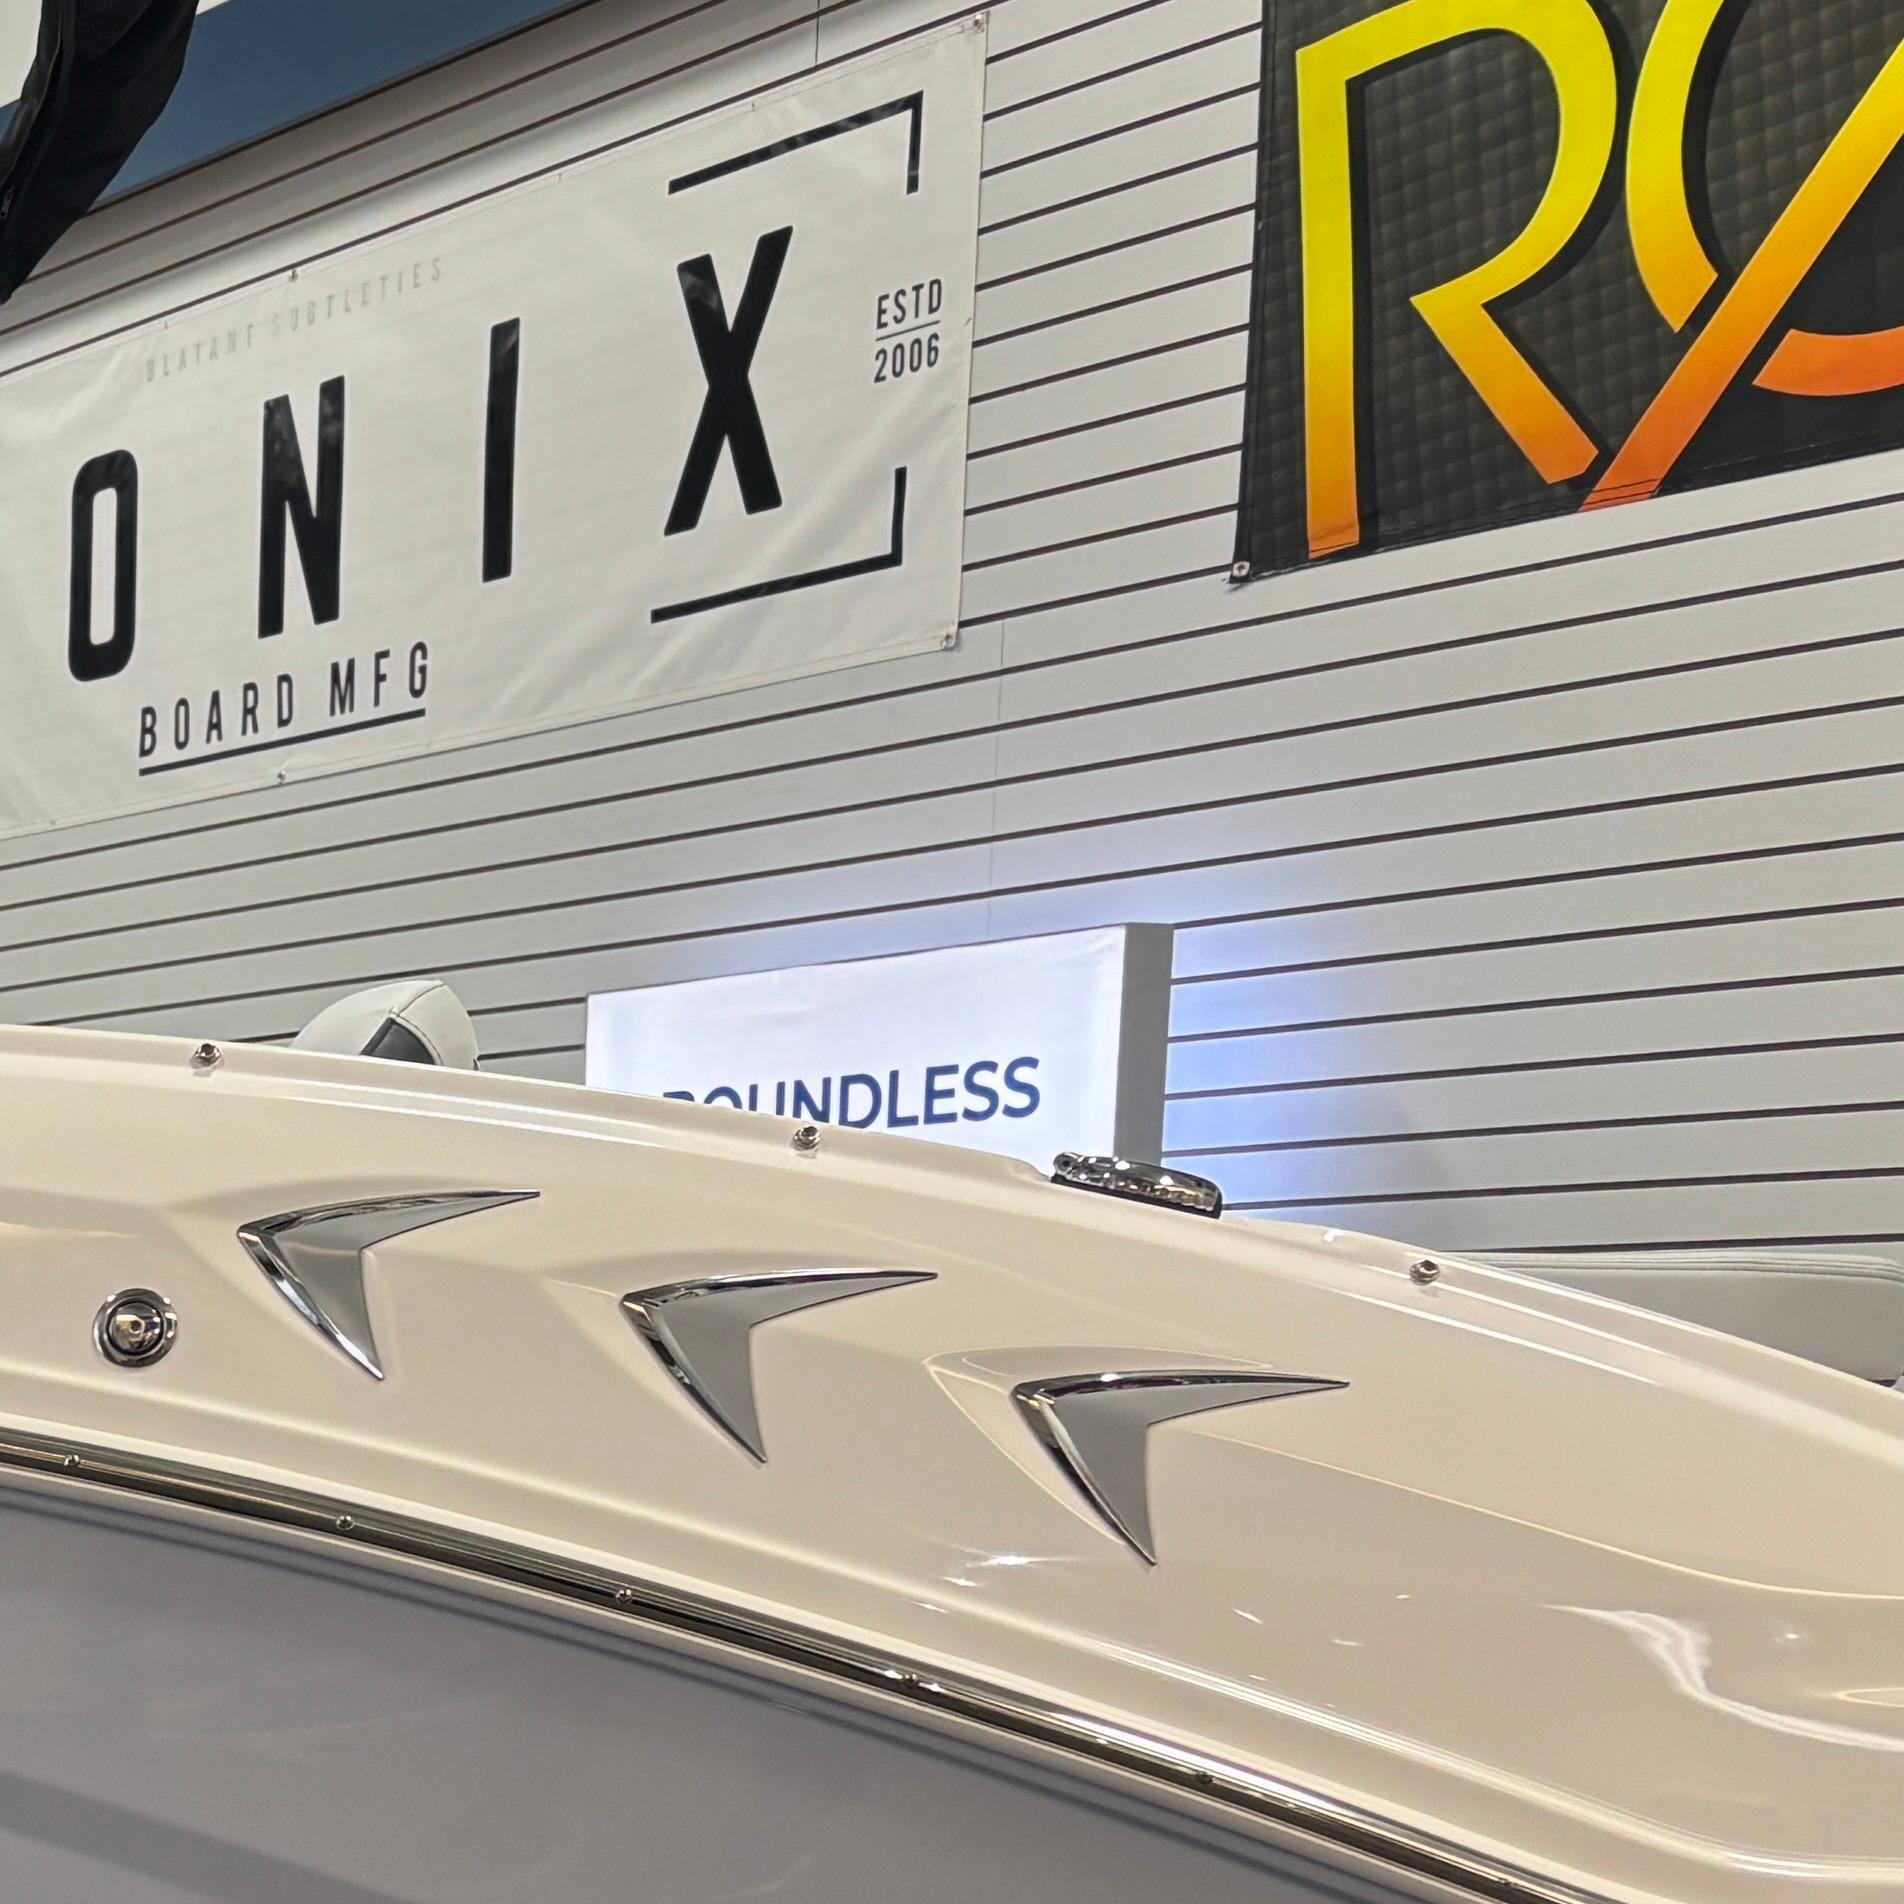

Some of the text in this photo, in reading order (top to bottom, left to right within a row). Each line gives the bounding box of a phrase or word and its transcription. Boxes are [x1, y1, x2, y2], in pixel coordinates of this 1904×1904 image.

[146, 256, 442, 382] BLATANT SUBTLETIES
[876, 278, 942, 330] ESTD
[873, 332, 940, 384] 2006
[139, 641, 428, 757] BOARD MFG
[663, 1056, 1041, 1130] NDLESS
